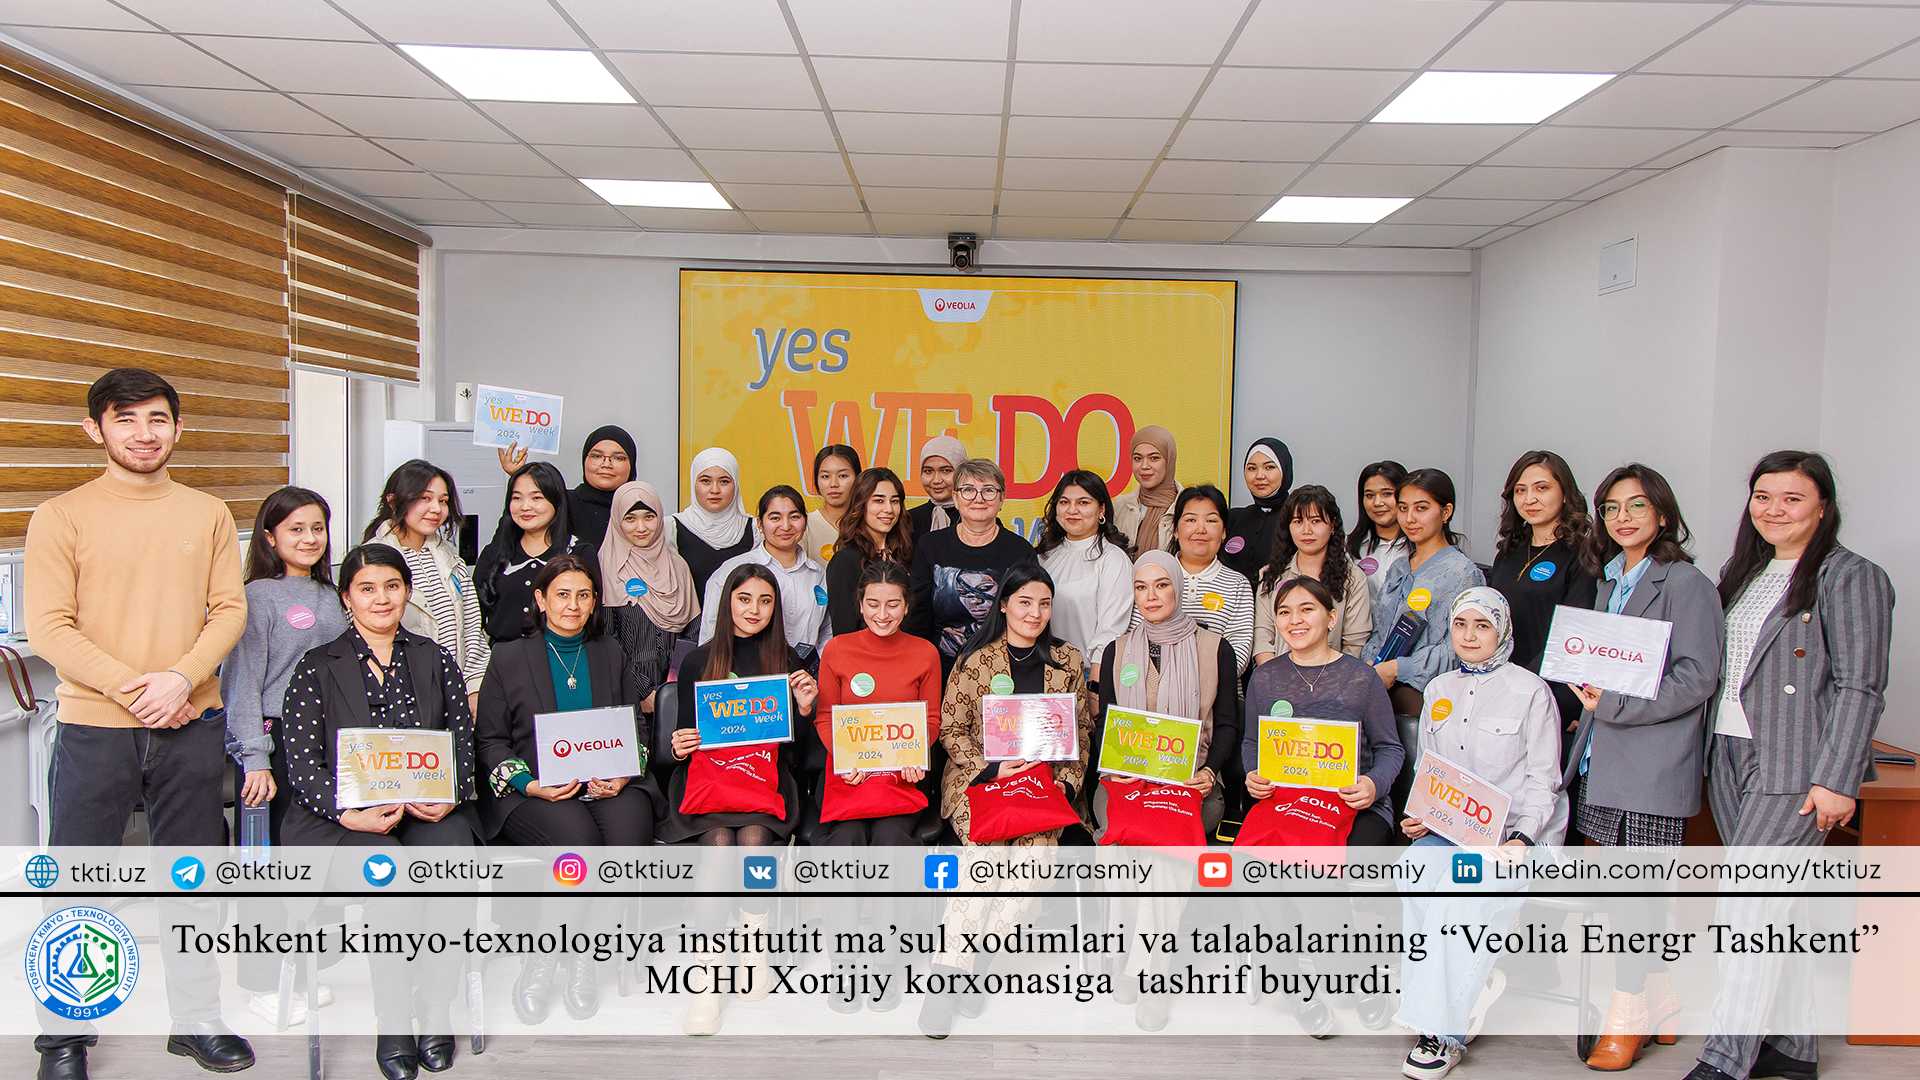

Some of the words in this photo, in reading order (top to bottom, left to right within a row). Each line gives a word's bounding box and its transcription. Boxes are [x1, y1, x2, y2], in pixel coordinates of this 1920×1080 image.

[946, 301, 976, 310] VEOLIA
[748, 326, 851, 391] yes
[489, 405, 523, 424] WE
[525, 410, 551, 427] DO
[781, 390, 973, 498] WE
[990, 393, 1136, 500] DO
[1588, 644, 1644, 663] VEOLIA
[703, 692, 722, 703] yes
[709, 699, 747, 719] WE
[749, 696, 778, 715] DO
[841, 717, 859, 726] yes
[720, 725, 746, 735] 2024
[847, 724, 883, 742] WE
[886, 724, 915, 740] DO
[1266, 729, 1287, 739] yes
[348, 741, 373, 752] yes
[574, 738, 623, 753] VEOLIA
[1118, 728, 1153, 750] WE
[1156, 735, 1185, 754] DO
[1273, 738, 1311, 757] WE
[1313, 742, 1344, 760] DO
[355, 751, 403, 770] WE
[406, 751, 440, 769] DO
[857, 751, 882, 760] 2024
[1283, 766, 1308, 776] 2024
[1426, 764, 1447, 778] yes
[369, 780, 401, 790] 2024
[1429, 775, 1467, 809] WE
[1463, 796, 1493, 825] DO
[1429, 806, 1454, 826] 2024
